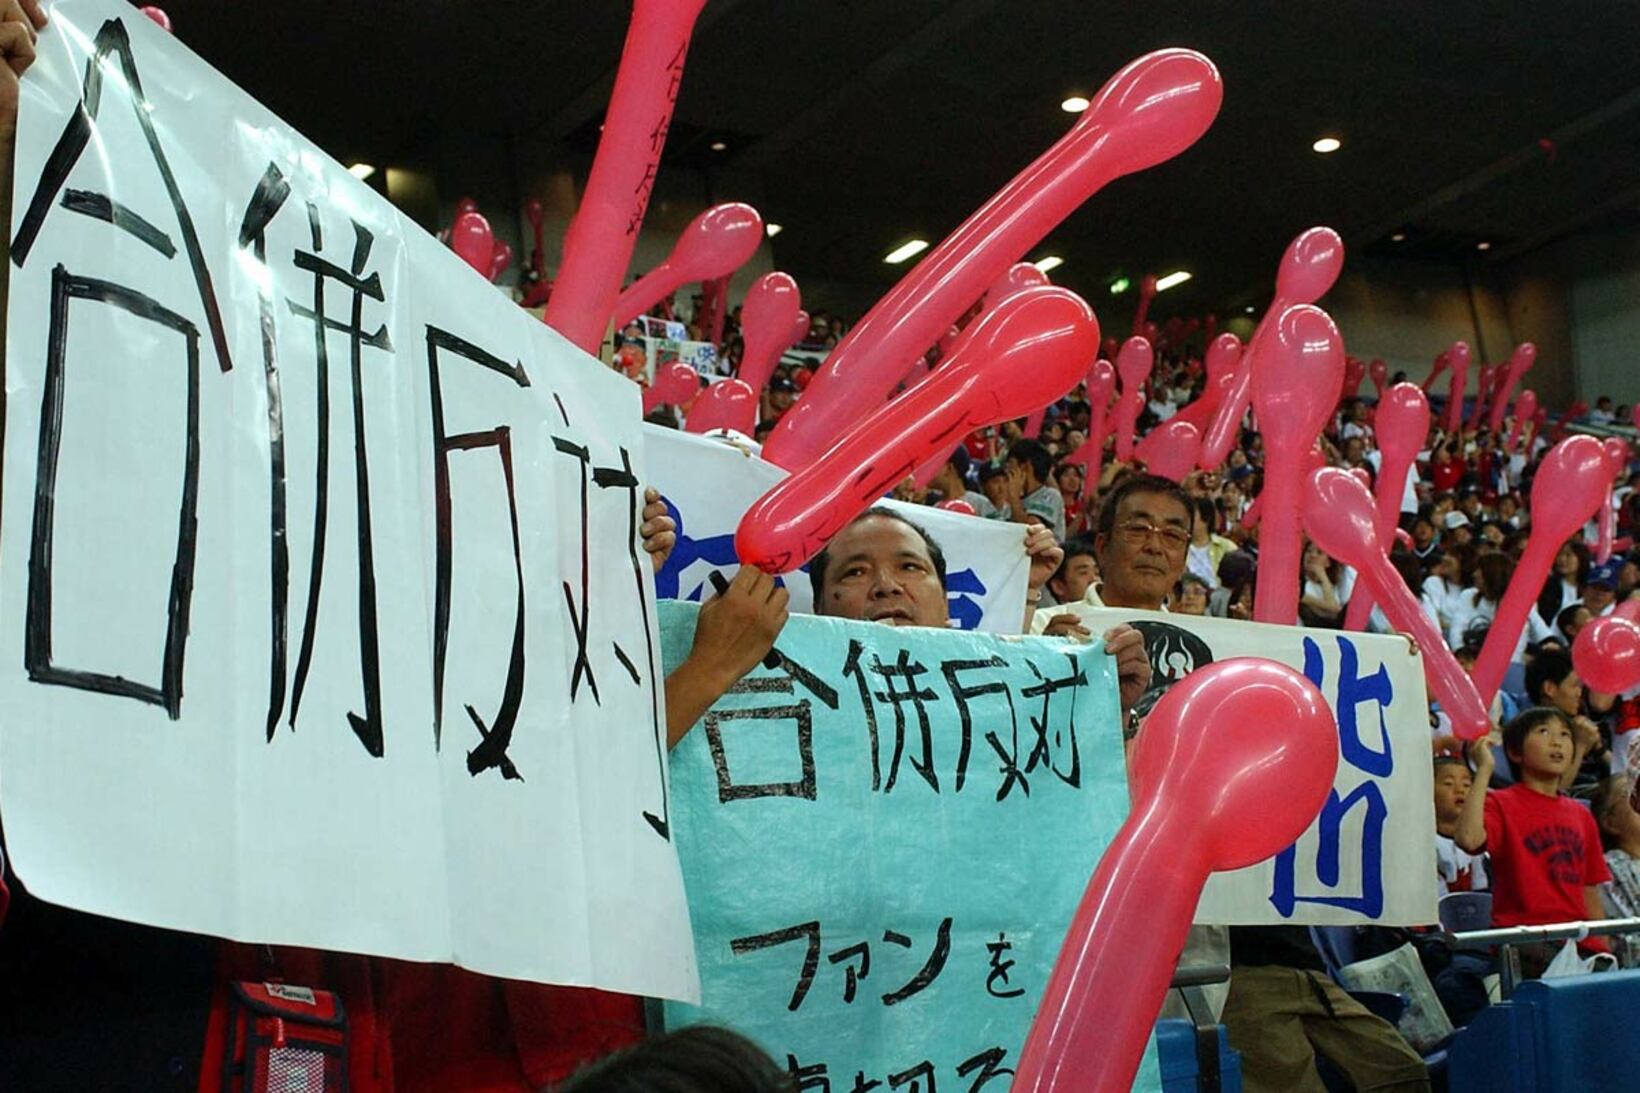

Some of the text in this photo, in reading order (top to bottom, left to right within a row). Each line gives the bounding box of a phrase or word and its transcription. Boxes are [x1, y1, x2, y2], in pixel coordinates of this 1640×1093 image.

[10, 17, 670, 840] 合併反対
[705, 638, 1088, 803] 合併反対
[730, 917, 1026, 1012] ファンを
